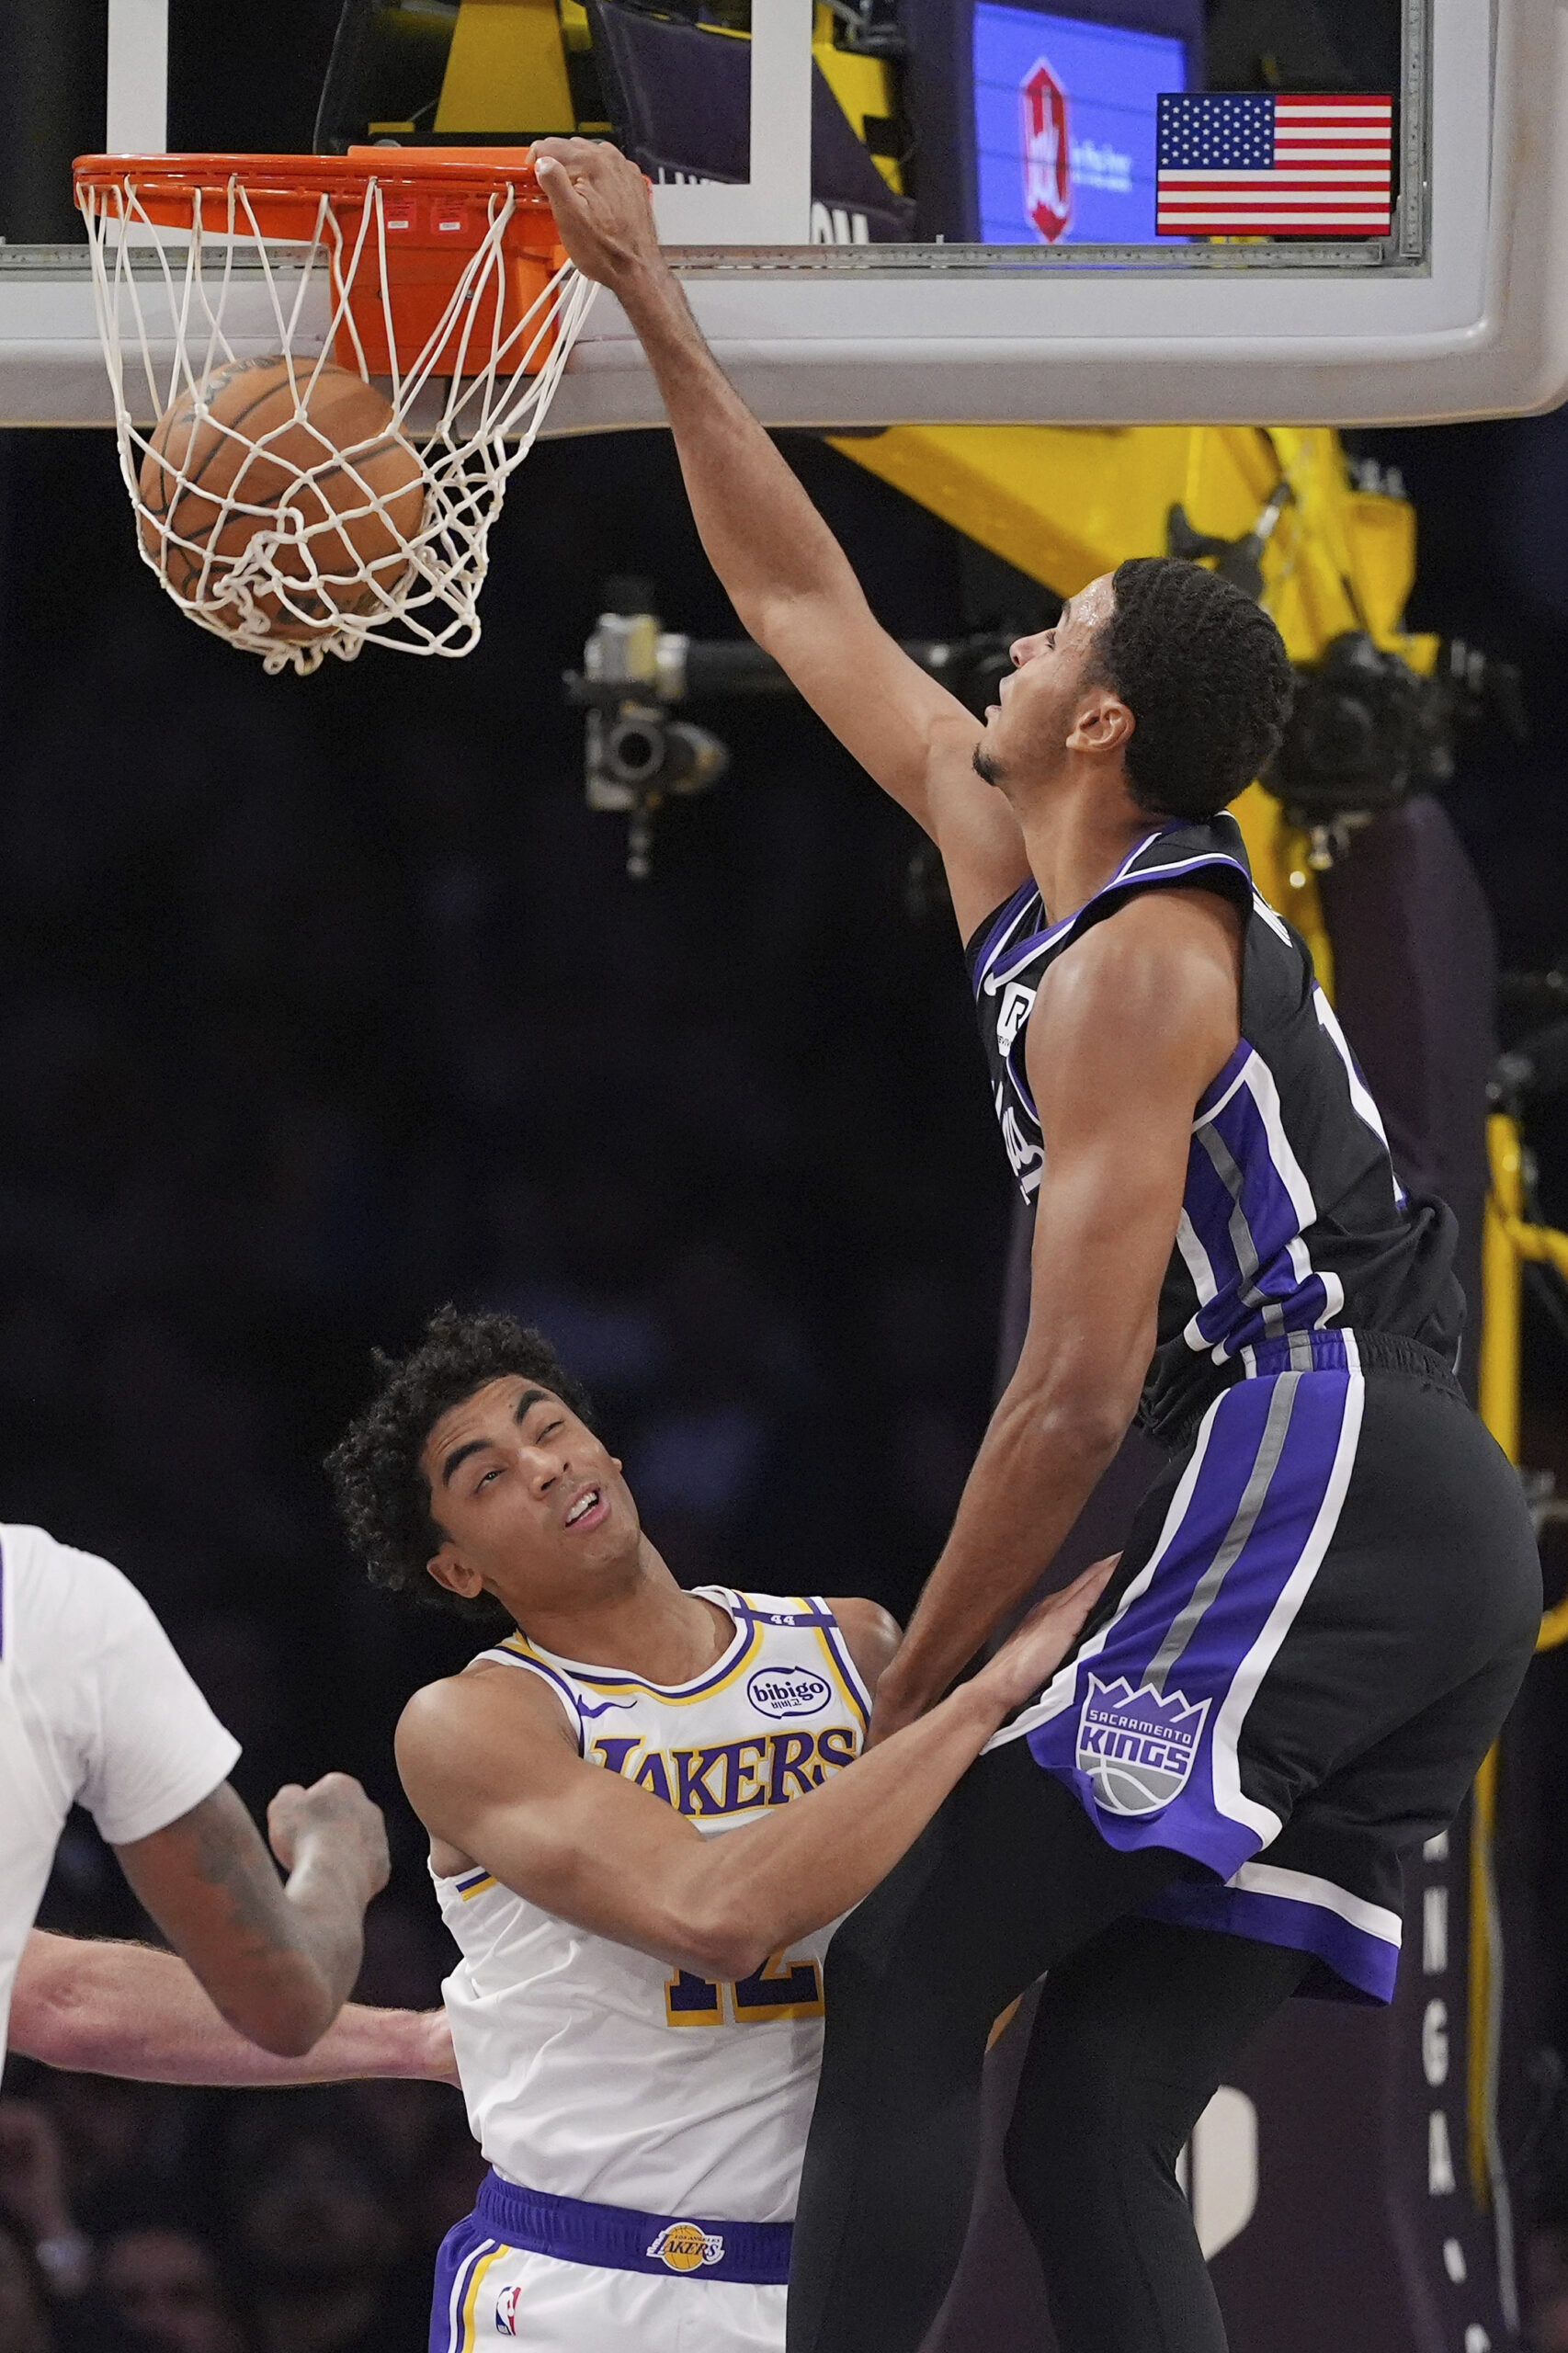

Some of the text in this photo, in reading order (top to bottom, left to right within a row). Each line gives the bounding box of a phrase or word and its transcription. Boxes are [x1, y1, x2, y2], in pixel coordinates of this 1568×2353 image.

[770, 1615, 795, 1626] 44
[753, 1681, 824, 1701] bibigo
[770, 1699, 802, 1709] 비비고
[1088, 1710, 1193, 1745] SACRAMENTO
[1079, 1725, 1191, 1776] KINGS
[653, 2234, 720, 2262] LAKERS
